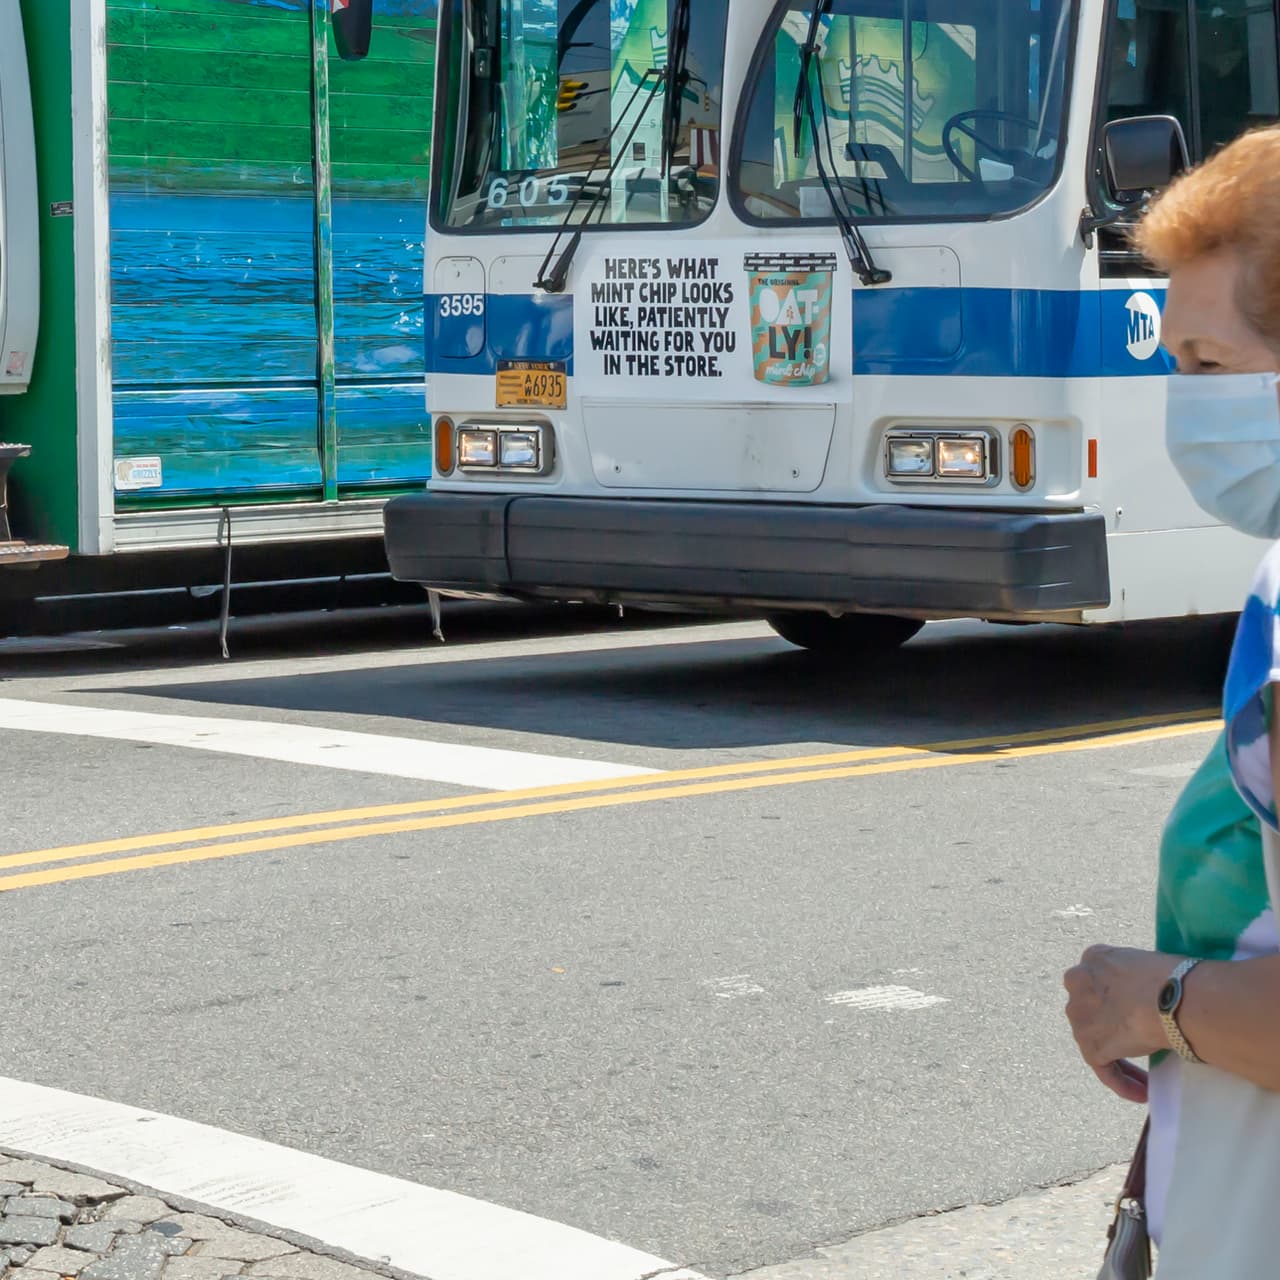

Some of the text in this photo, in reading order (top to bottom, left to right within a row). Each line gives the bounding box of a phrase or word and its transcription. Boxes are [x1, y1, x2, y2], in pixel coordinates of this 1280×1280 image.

[605, 258, 719, 279] HERE'S WHAT
[591, 283, 734, 303] MINT CHIP LOOKS
[440, 294, 484, 317] 3595
[595, 307, 730, 329] LIKE, PATIENTLY
[1123, 307, 1155, 345] MTA
[590, 331, 736, 353] WAITING FOR YOU
[768, 326, 813, 360] LY!
[604, 355, 723, 377] IN THE STORE.
